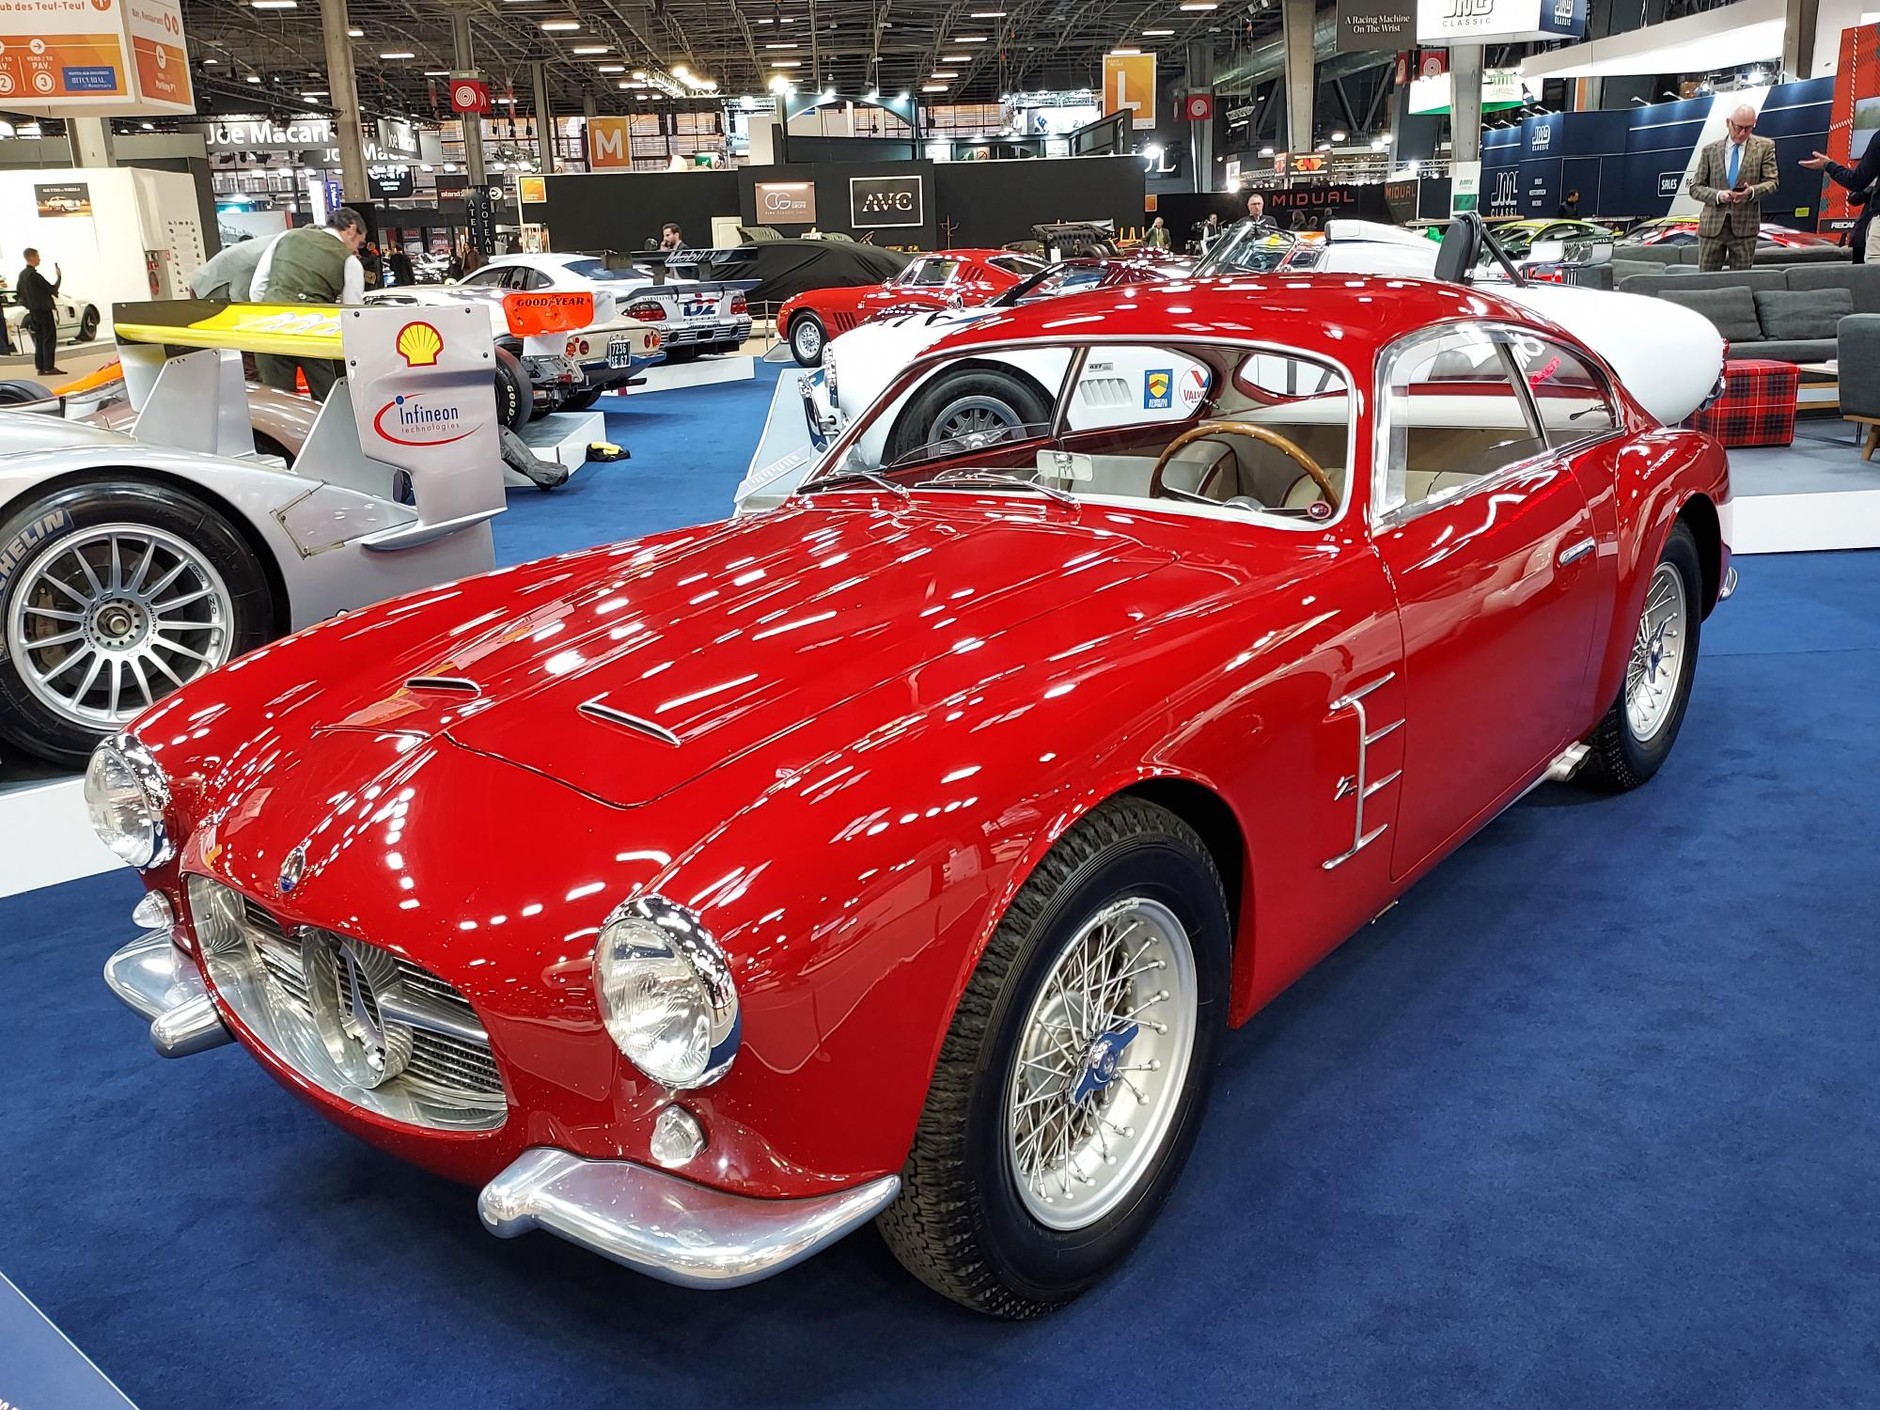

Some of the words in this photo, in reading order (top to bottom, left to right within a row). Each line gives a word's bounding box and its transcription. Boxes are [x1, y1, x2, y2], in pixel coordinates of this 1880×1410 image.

[0, 3, 12, 11] ub
[15, 2, 33, 11] des
[1345, 16, 1352, 24] A
[1352, 15, 1378, 25] Racing
[1379, 14, 1410, 24] Machine
[1442, 17, 1492, 28] CLASSIC
[1353, 25, 1365, 33] On
[1365, 25, 1380, 33] The
[1381, 24, 1401, 33] Wrist
[32, 62, 52, 70] PAV.
[41, 77, 47, 87] 3
[1118, 71, 1142, 110] L
[207, 123, 245, 146] Joe
[595, 129, 624, 160] M
[1661, 178, 1678, 190] SALES
[1385, 183, 1416, 200] MIDUAL
[1272, 190, 1355, 207] MIDUAL
[481, 201, 495, 254] COTEAU
[664, 250, 707, 263] Mobil
[399, 404, 459, 426] Infineon
[401, 423, 460, 435] technologies
[0, 510, 65, 592] HELIN
